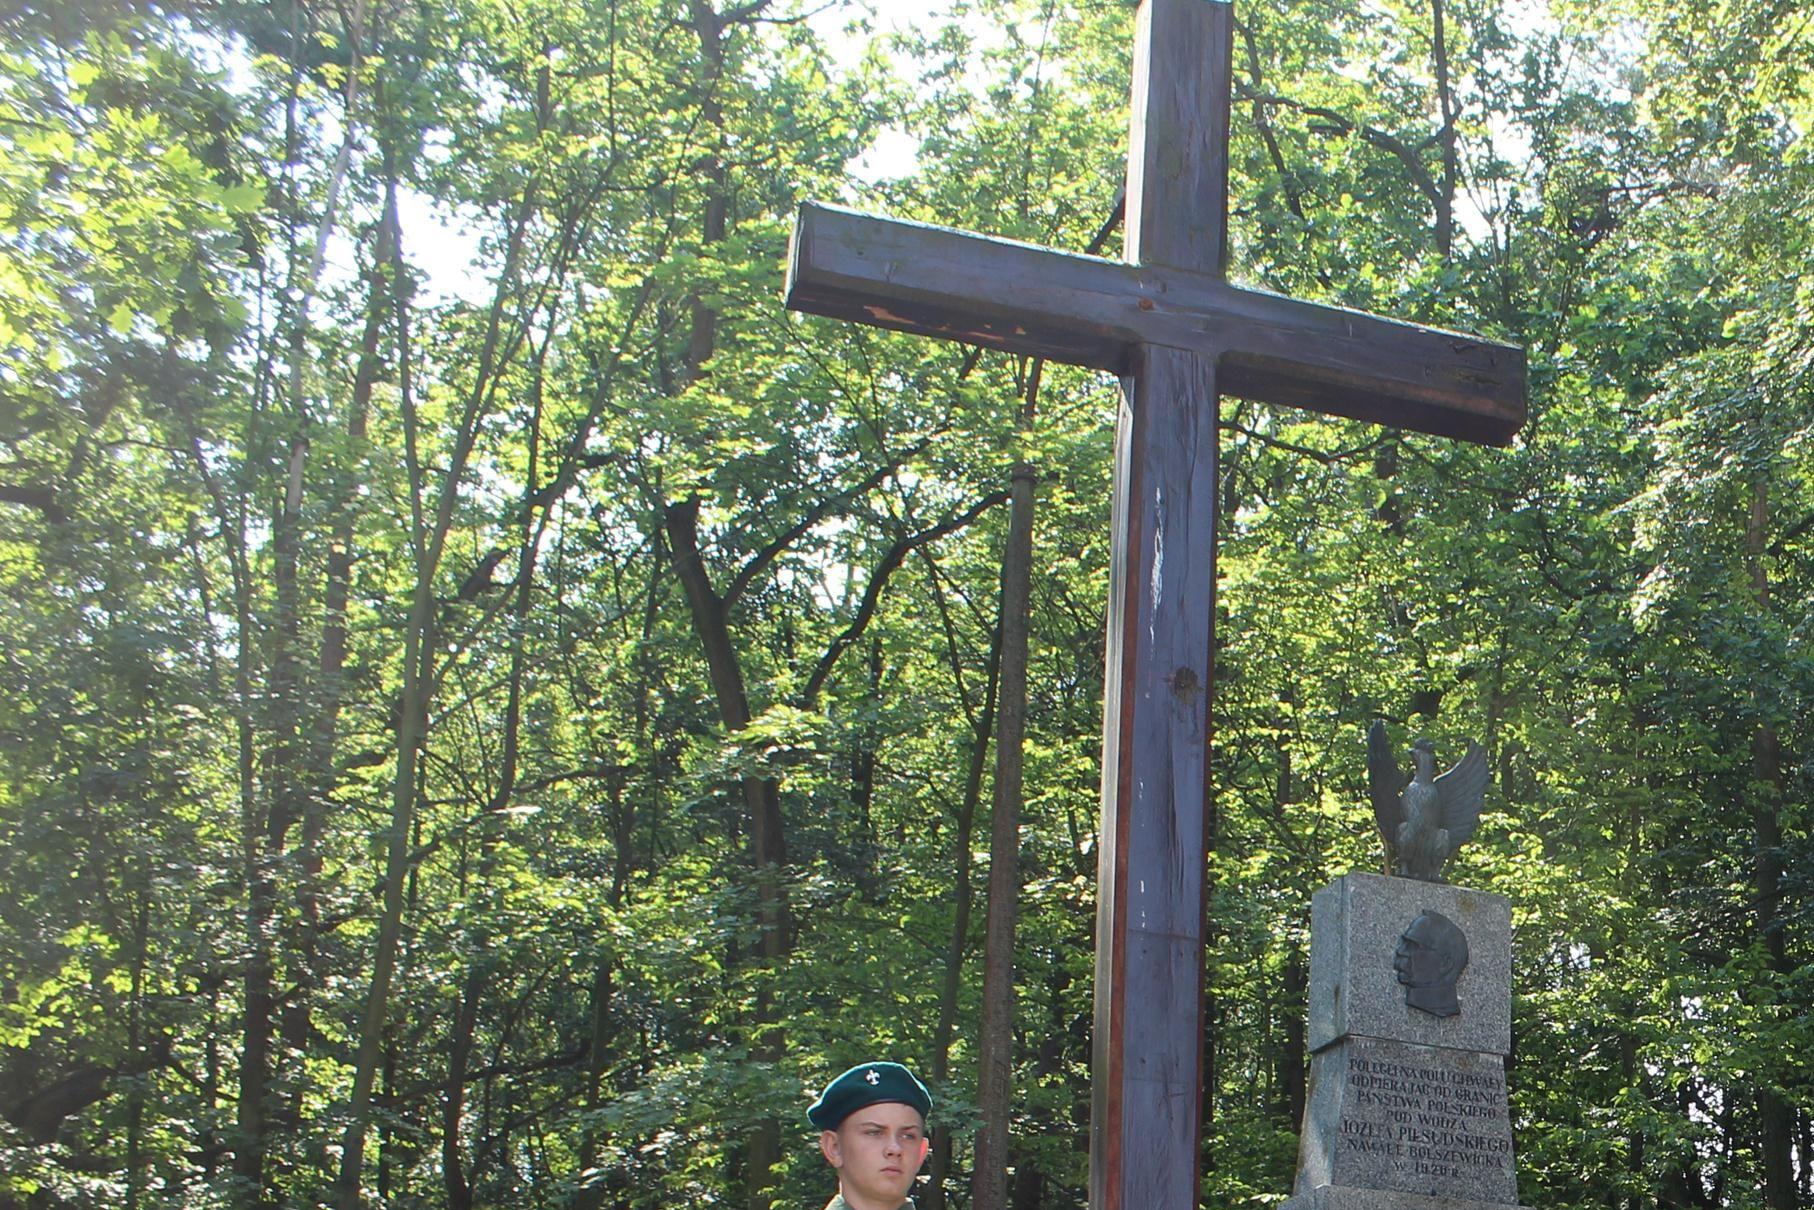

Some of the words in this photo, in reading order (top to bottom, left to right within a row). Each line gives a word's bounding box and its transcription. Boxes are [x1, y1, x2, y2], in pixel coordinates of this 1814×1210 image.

[1420, 1069, 1449, 1083] POLU
[1435, 1084, 1452, 1099] OD
[1455, 1088, 1503, 1106] GRANIC
[1428, 1098, 1497, 1121] POLSKIEGO
[1400, 1126, 1510, 1154] PIŁSUDSKIEGO
[1415, 1161, 1448, 1177] 1920
